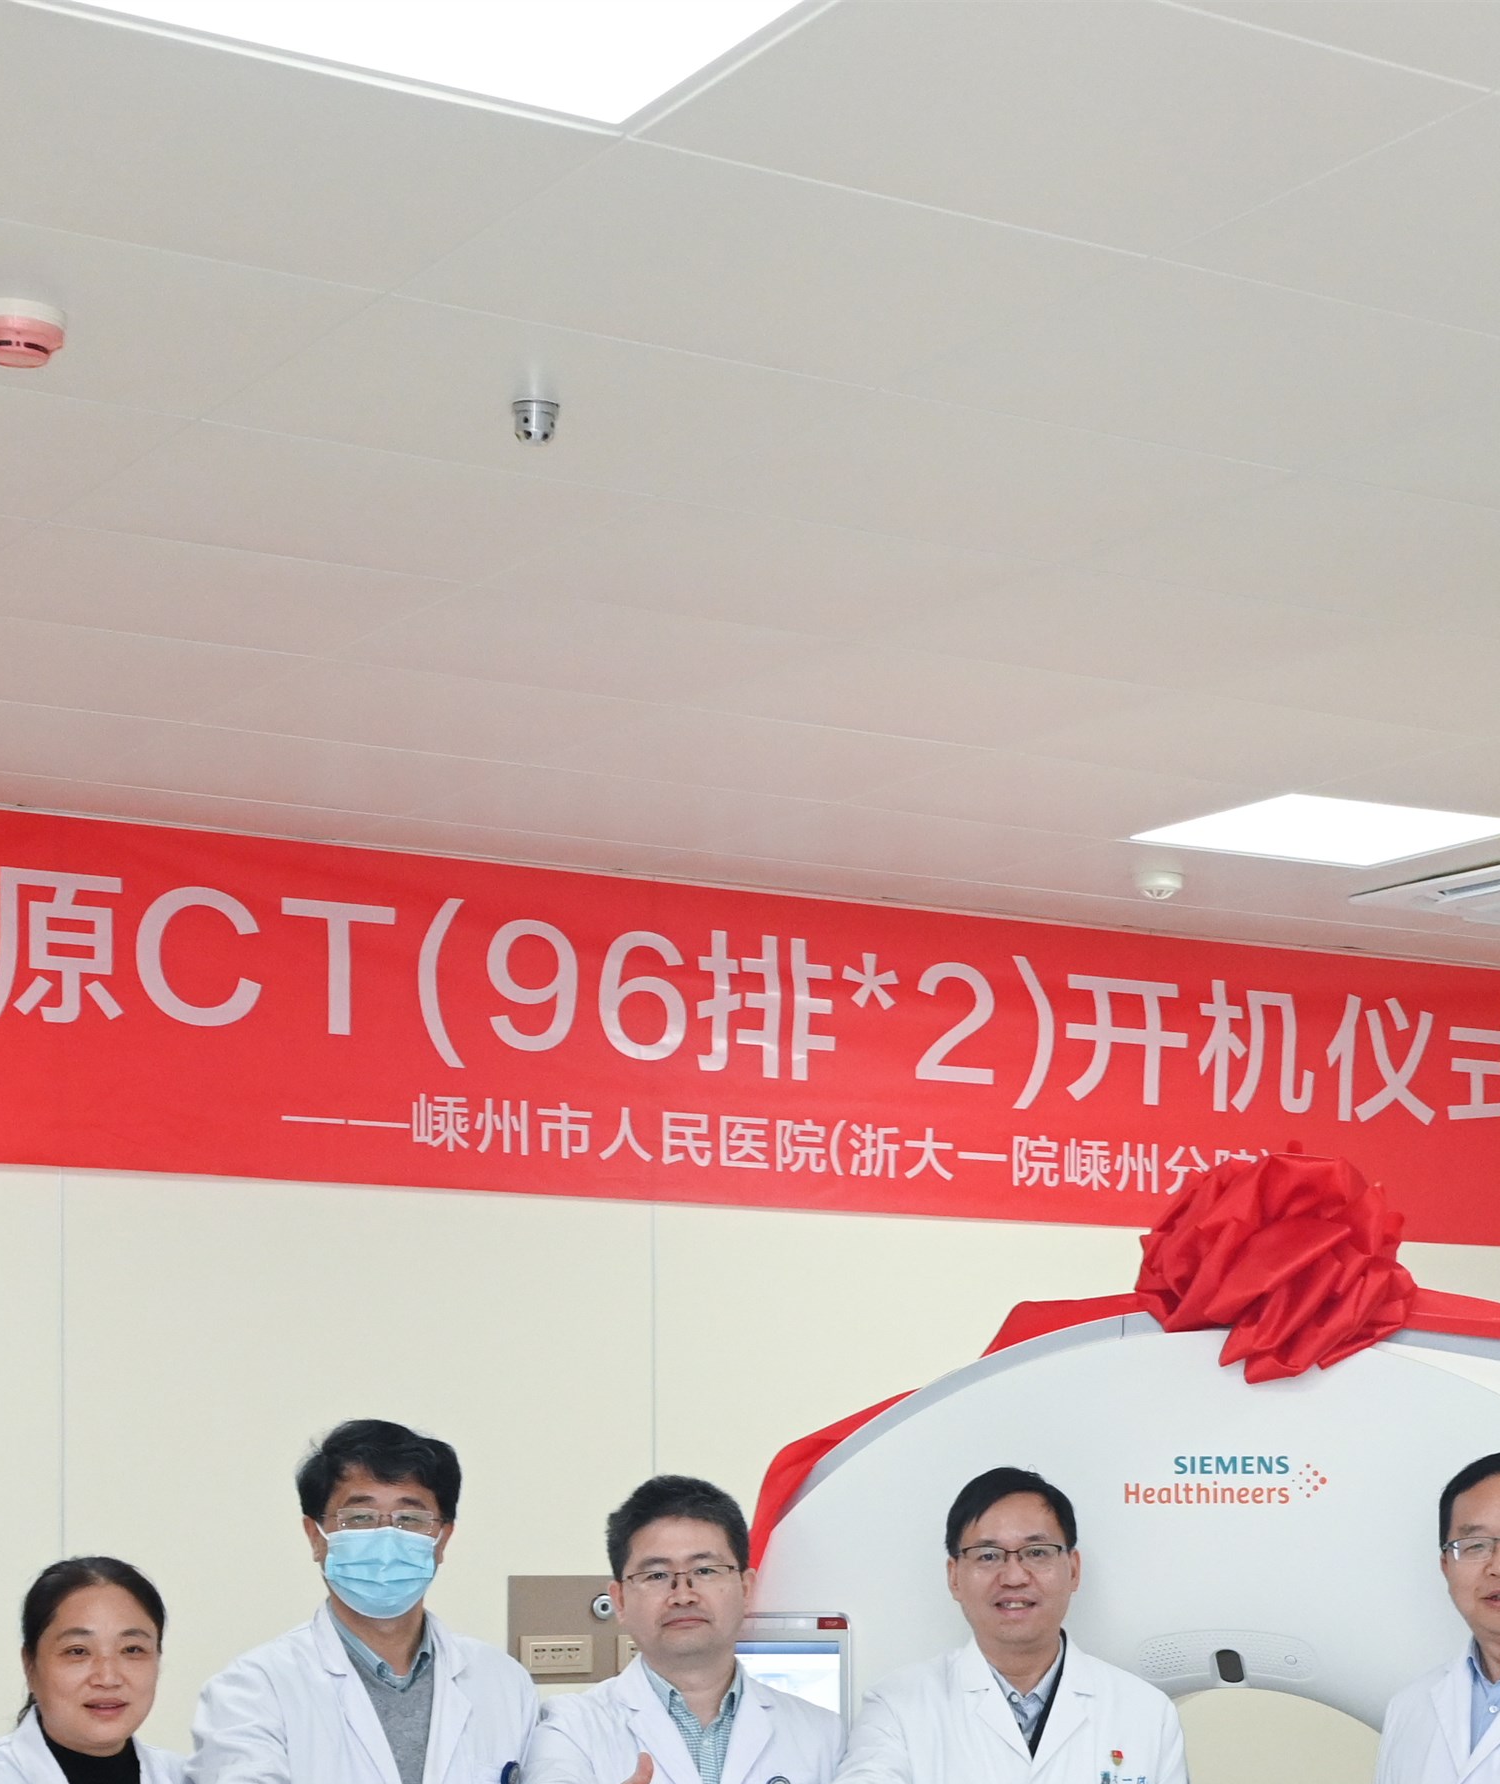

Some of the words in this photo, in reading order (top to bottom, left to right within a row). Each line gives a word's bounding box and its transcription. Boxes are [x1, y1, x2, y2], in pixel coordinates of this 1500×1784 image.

[281, 1093, 1270, 1195] ——嵊州市人民医院(浙大一院嵊州分
[1174, 1456, 1290, 1475] SIEMENS
[1124, 1481, 1290, 1504] Healthineers
